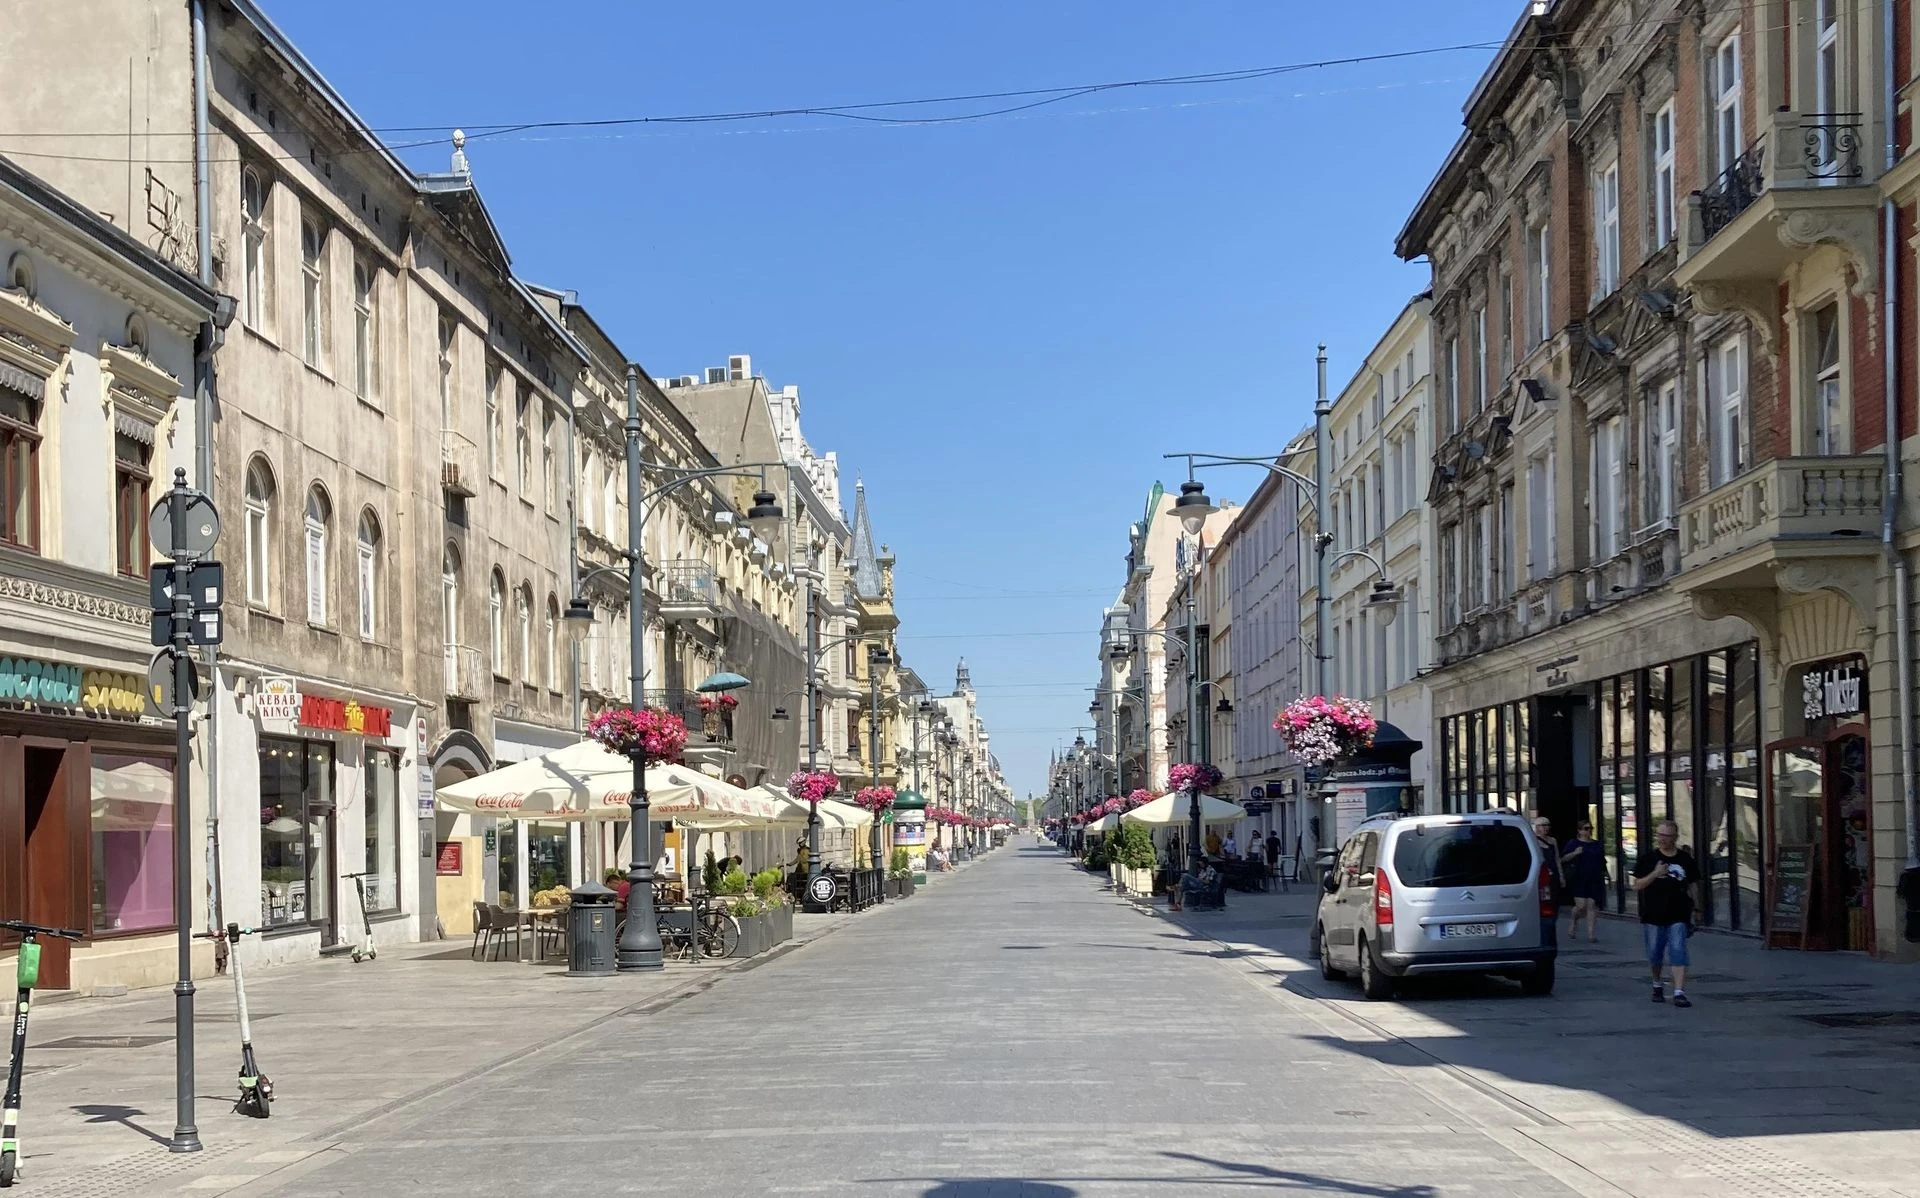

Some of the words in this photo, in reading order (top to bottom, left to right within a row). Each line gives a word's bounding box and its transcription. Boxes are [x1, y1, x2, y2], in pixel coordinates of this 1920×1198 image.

[1824, 667, 1861, 715] folkstar
[258, 693, 296, 705] KEBAB
[263, 705, 290, 717] KING
[1447, 926, 1461, 936] EL
[16, 1014, 27, 1035] Lime
